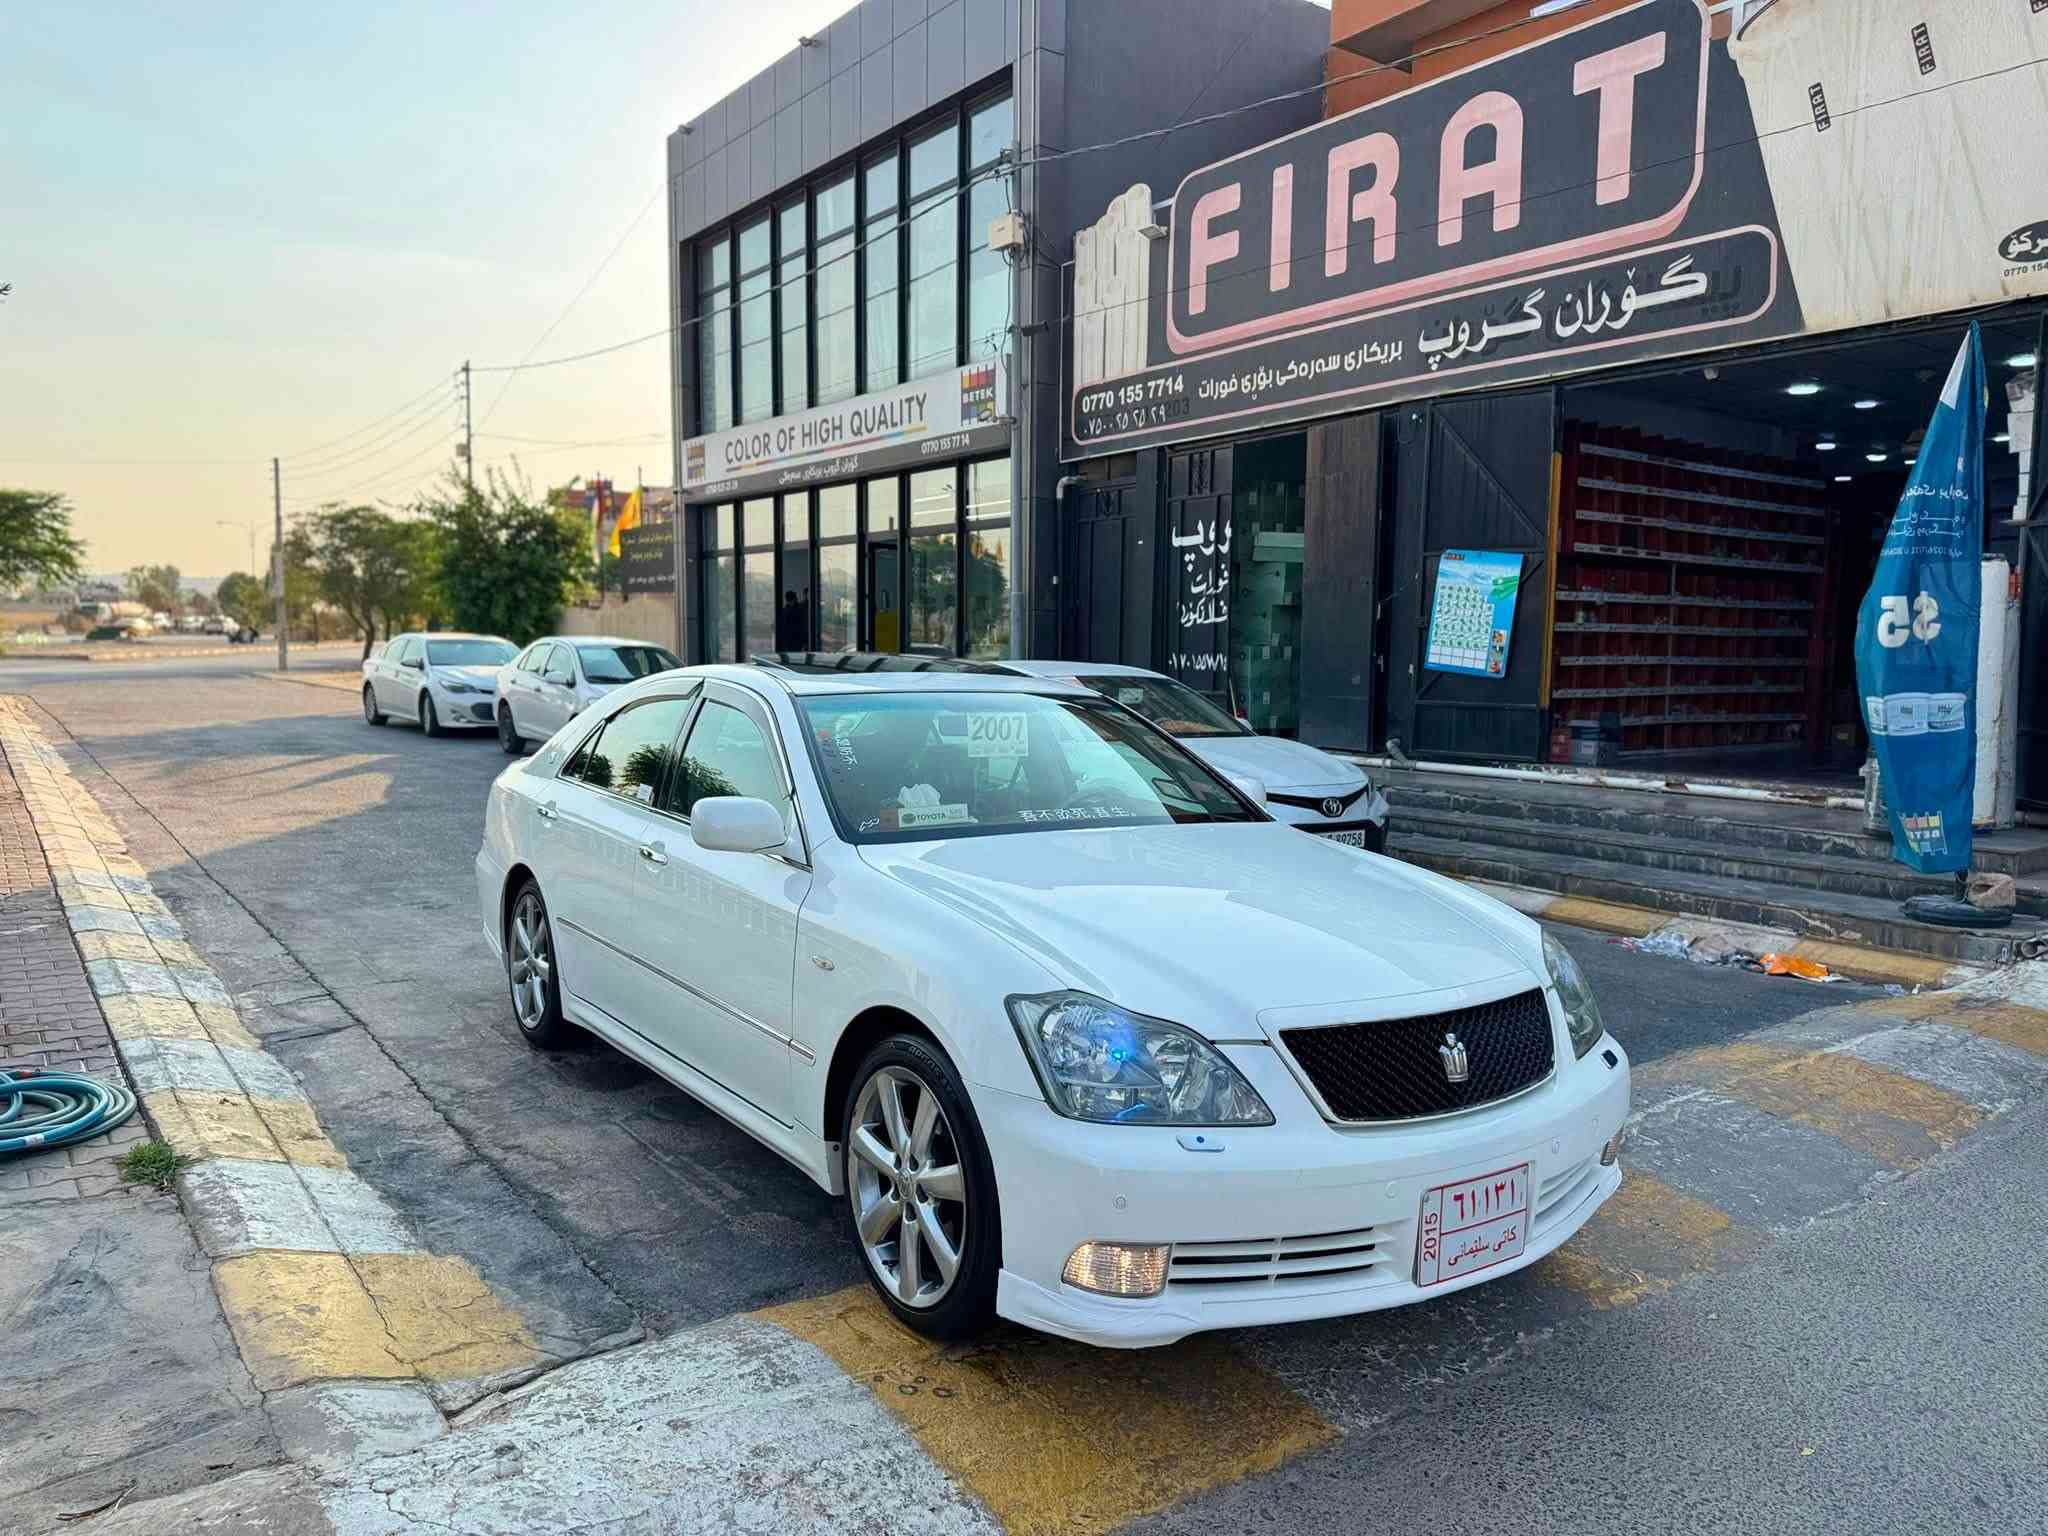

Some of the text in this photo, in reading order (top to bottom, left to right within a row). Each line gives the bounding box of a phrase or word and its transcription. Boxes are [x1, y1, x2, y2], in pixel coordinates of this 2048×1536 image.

[1913, 25, 1936, 75] FIRAT
[1809, 84, 1830, 131] FIRAT
[1188, 31, 1667, 316] FIRAT
[962, 387, 994, 405] BETEK
[1082, 374, 1184, 413] 0770 155 7714
[1198, 374, 1238, 400] فورات
[725, 391, 929, 465] COLOR OF HIGH QUALITY
[920, 439, 939, 455] 0770
[971, 715, 1023, 741] 2007
[915, 812, 946, 822] TOYOTA
[1452, 1178, 1516, 1222] ٦١١٣١
[1423, 1212, 1439, 1262] 2015
